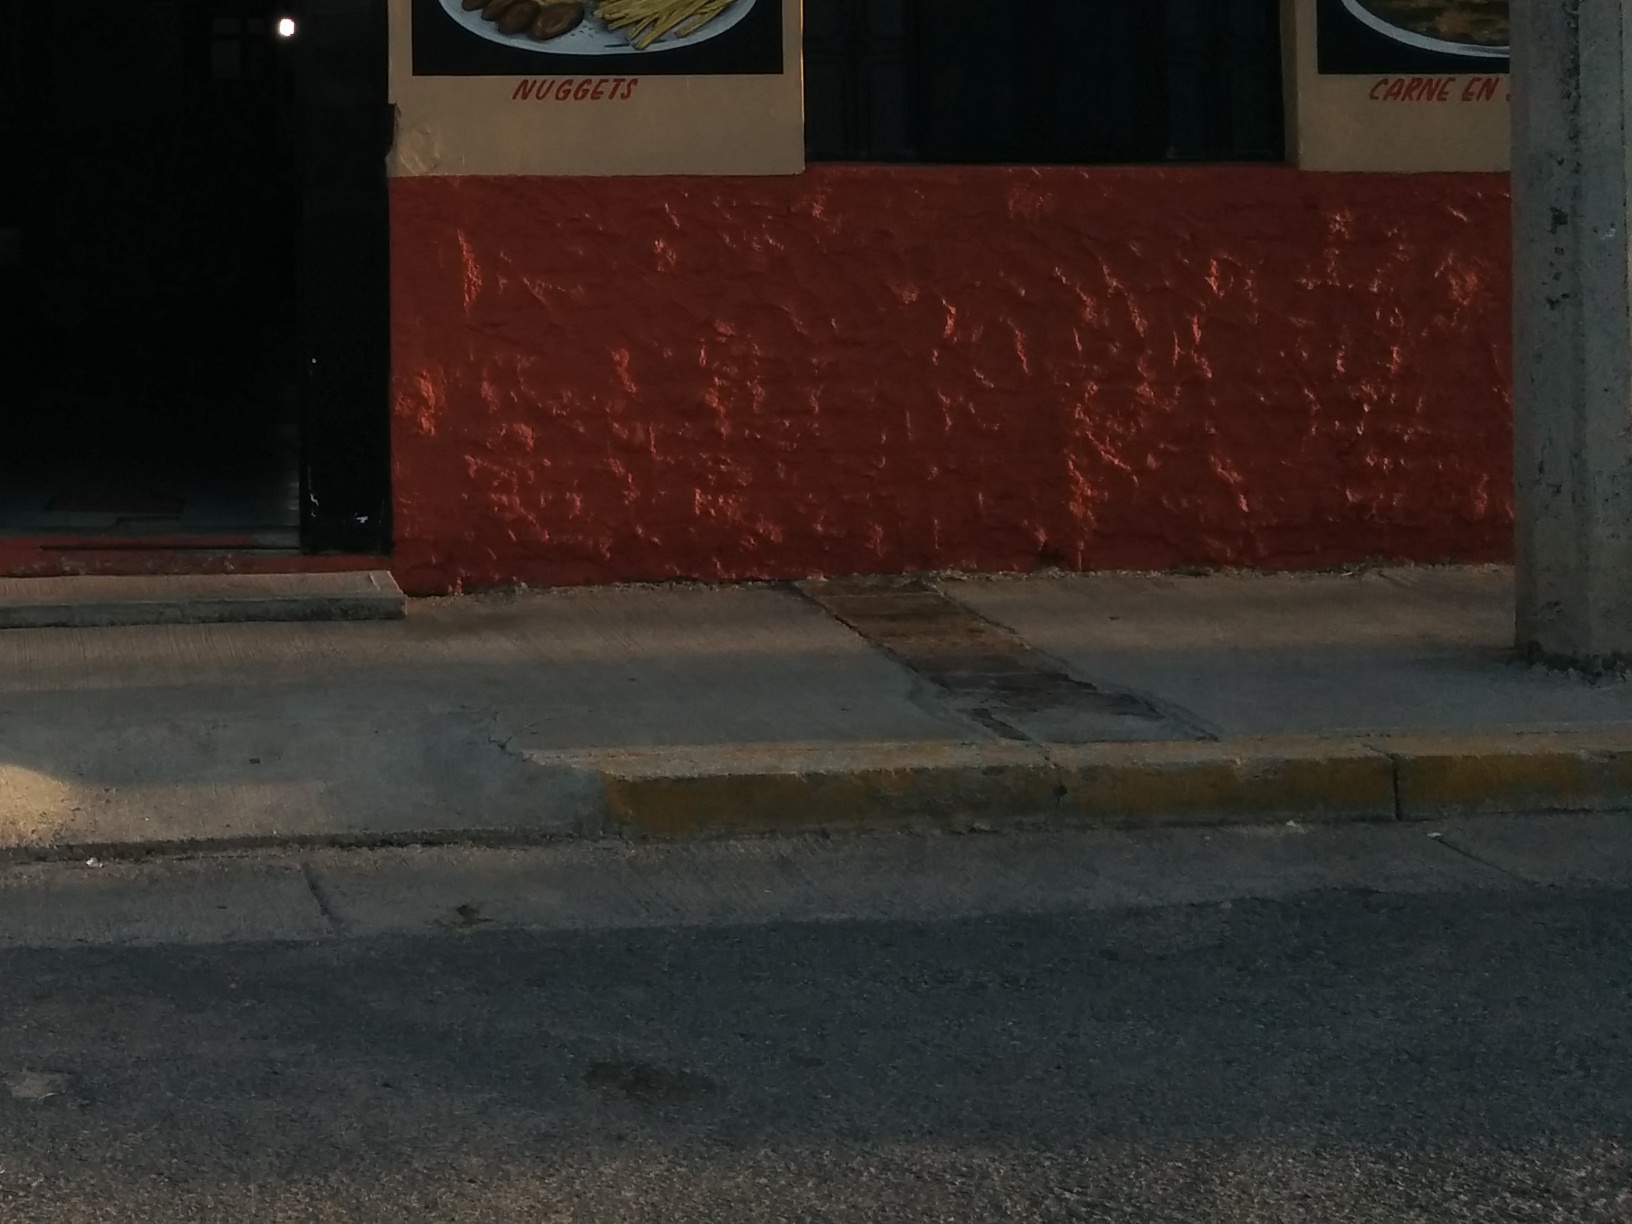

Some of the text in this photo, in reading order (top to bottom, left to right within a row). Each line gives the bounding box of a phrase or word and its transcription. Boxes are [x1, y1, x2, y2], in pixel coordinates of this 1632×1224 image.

[511, 78, 639, 101] NUGGETS
[1369, 77, 1500, 102] CARNE EN
